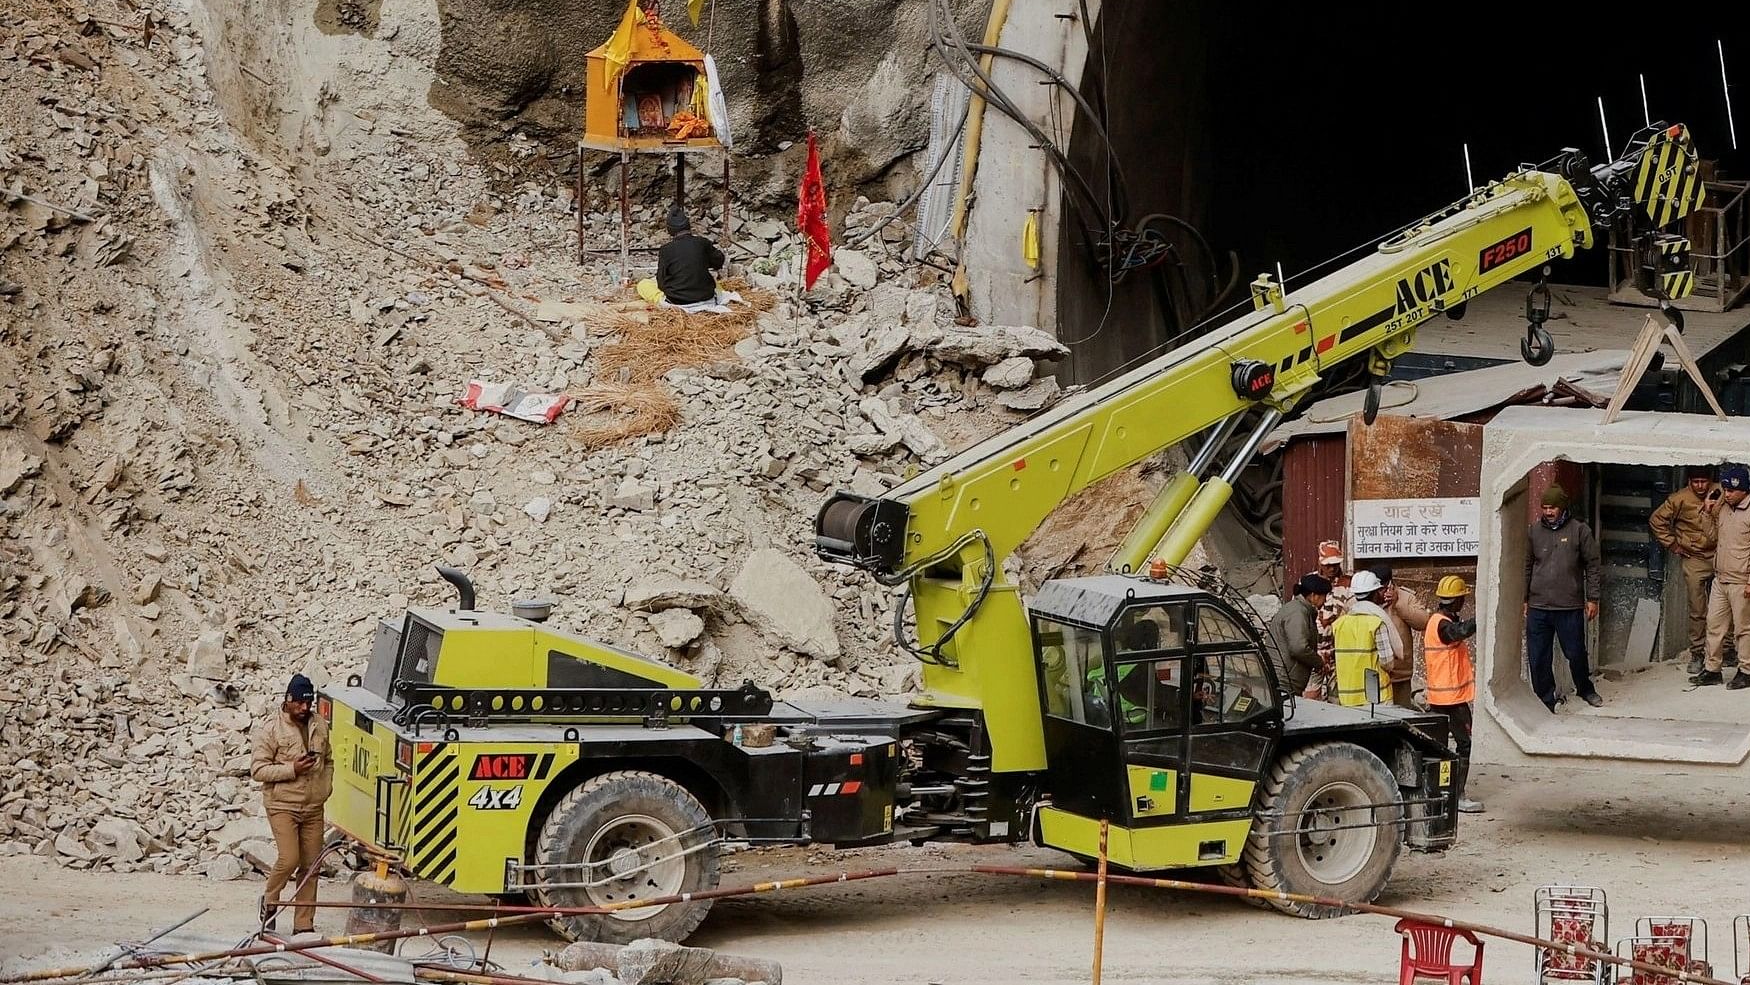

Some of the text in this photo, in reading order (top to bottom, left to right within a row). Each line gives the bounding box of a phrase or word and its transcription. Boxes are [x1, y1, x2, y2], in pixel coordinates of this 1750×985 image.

[1658, 166, 1678, 184] 0.9T
[1483, 233, 1529, 270] F250
[1545, 245, 1562, 259] 13T
[1395, 258, 1455, 316] ACE
[1462, 286, 1480, 301] 17T
[1385, 307, 1424, 334] 25T 20T
[1251, 372, 1272, 392] ACE
[1384, 506, 1412, 519] याद
[1357, 526, 1378, 541] सुरक्षा
[1380, 521, 1403, 536] नियम
[1405, 521, 1418, 536] जो
[1441, 524, 1469, 536] सफल
[1357, 540, 1382, 554] जीवन
[1383, 539, 1402, 553] कभी
[1404, 542, 1413, 553] न
[1415, 539, 1427, 555] हो
[1428, 541, 1455, 553] उसका
[352, 743, 371, 781] ACE
[475, 756, 527, 779] ACE
[468, 785, 524, 810] 4x4
